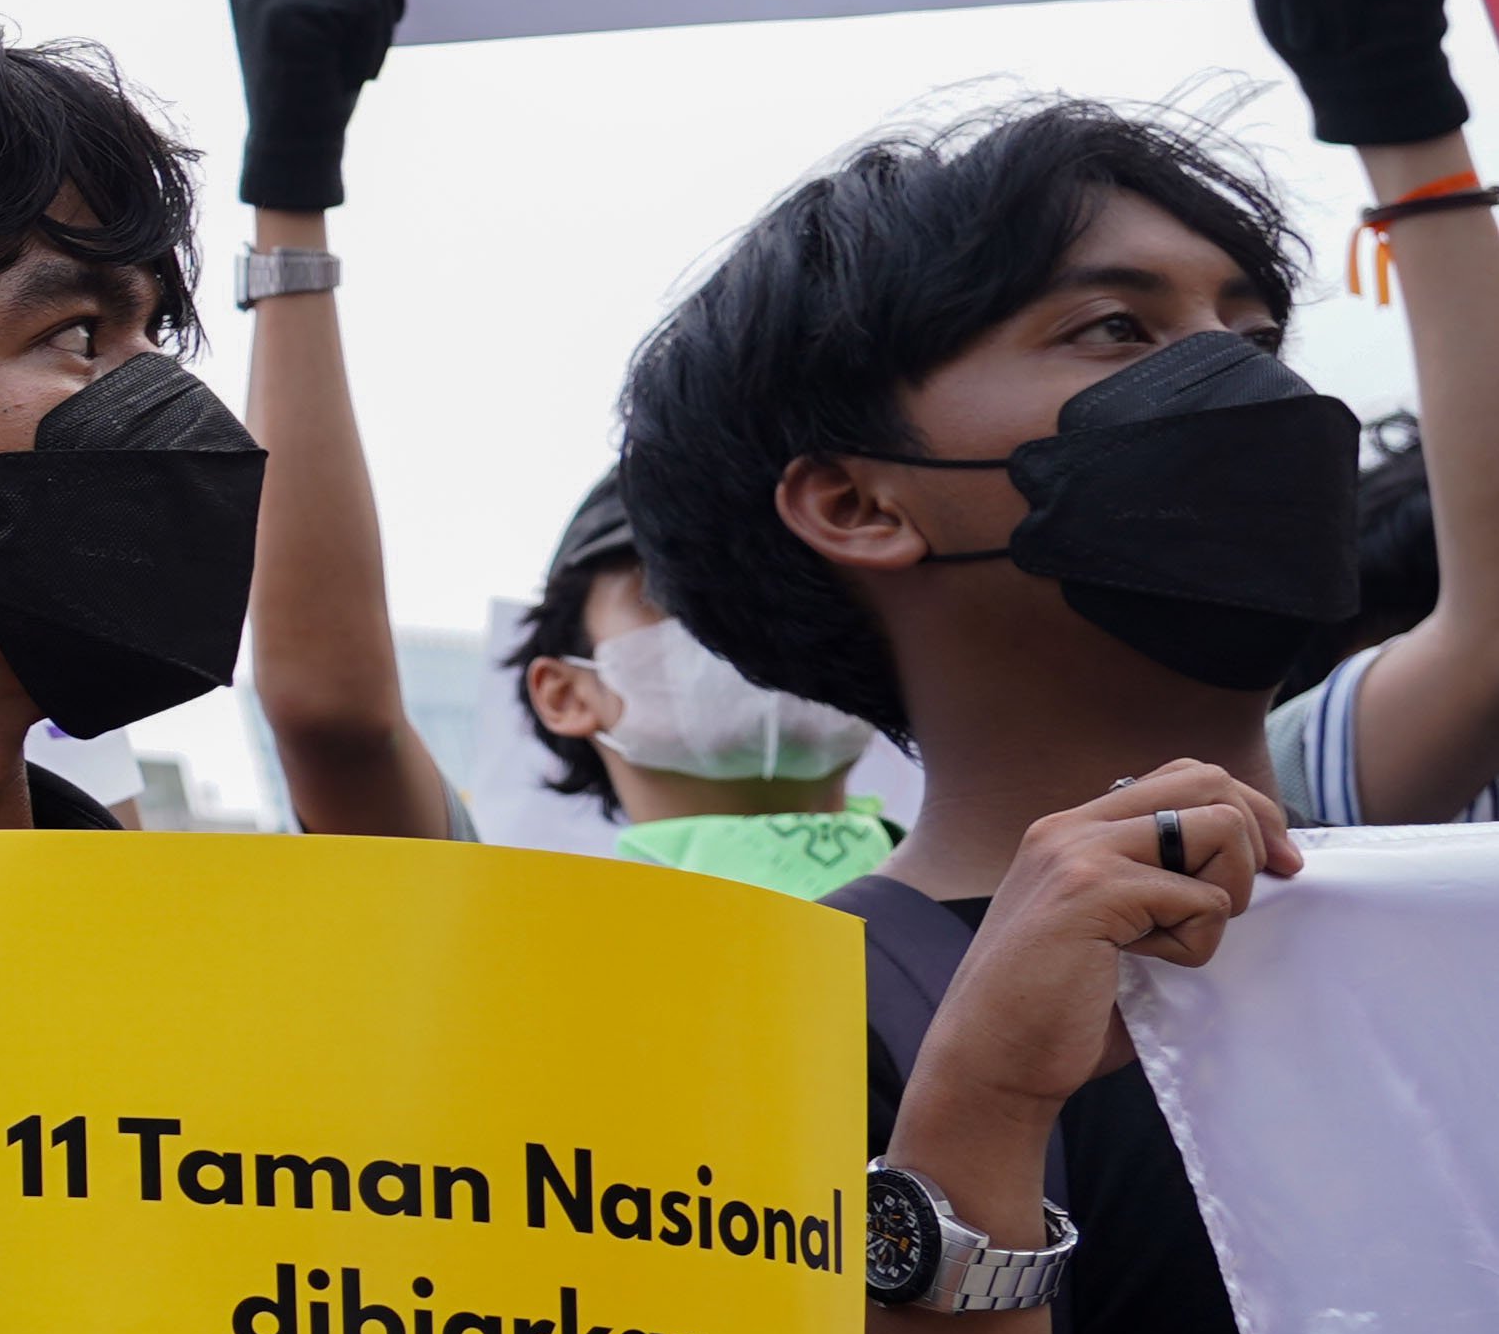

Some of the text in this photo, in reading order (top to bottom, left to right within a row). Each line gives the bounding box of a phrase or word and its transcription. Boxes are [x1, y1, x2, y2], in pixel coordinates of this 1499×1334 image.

[5, 1113, 91, 1200] 11
[117, 1116, 492, 1223] Taman
[524, 1141, 845, 1275] Nasional
